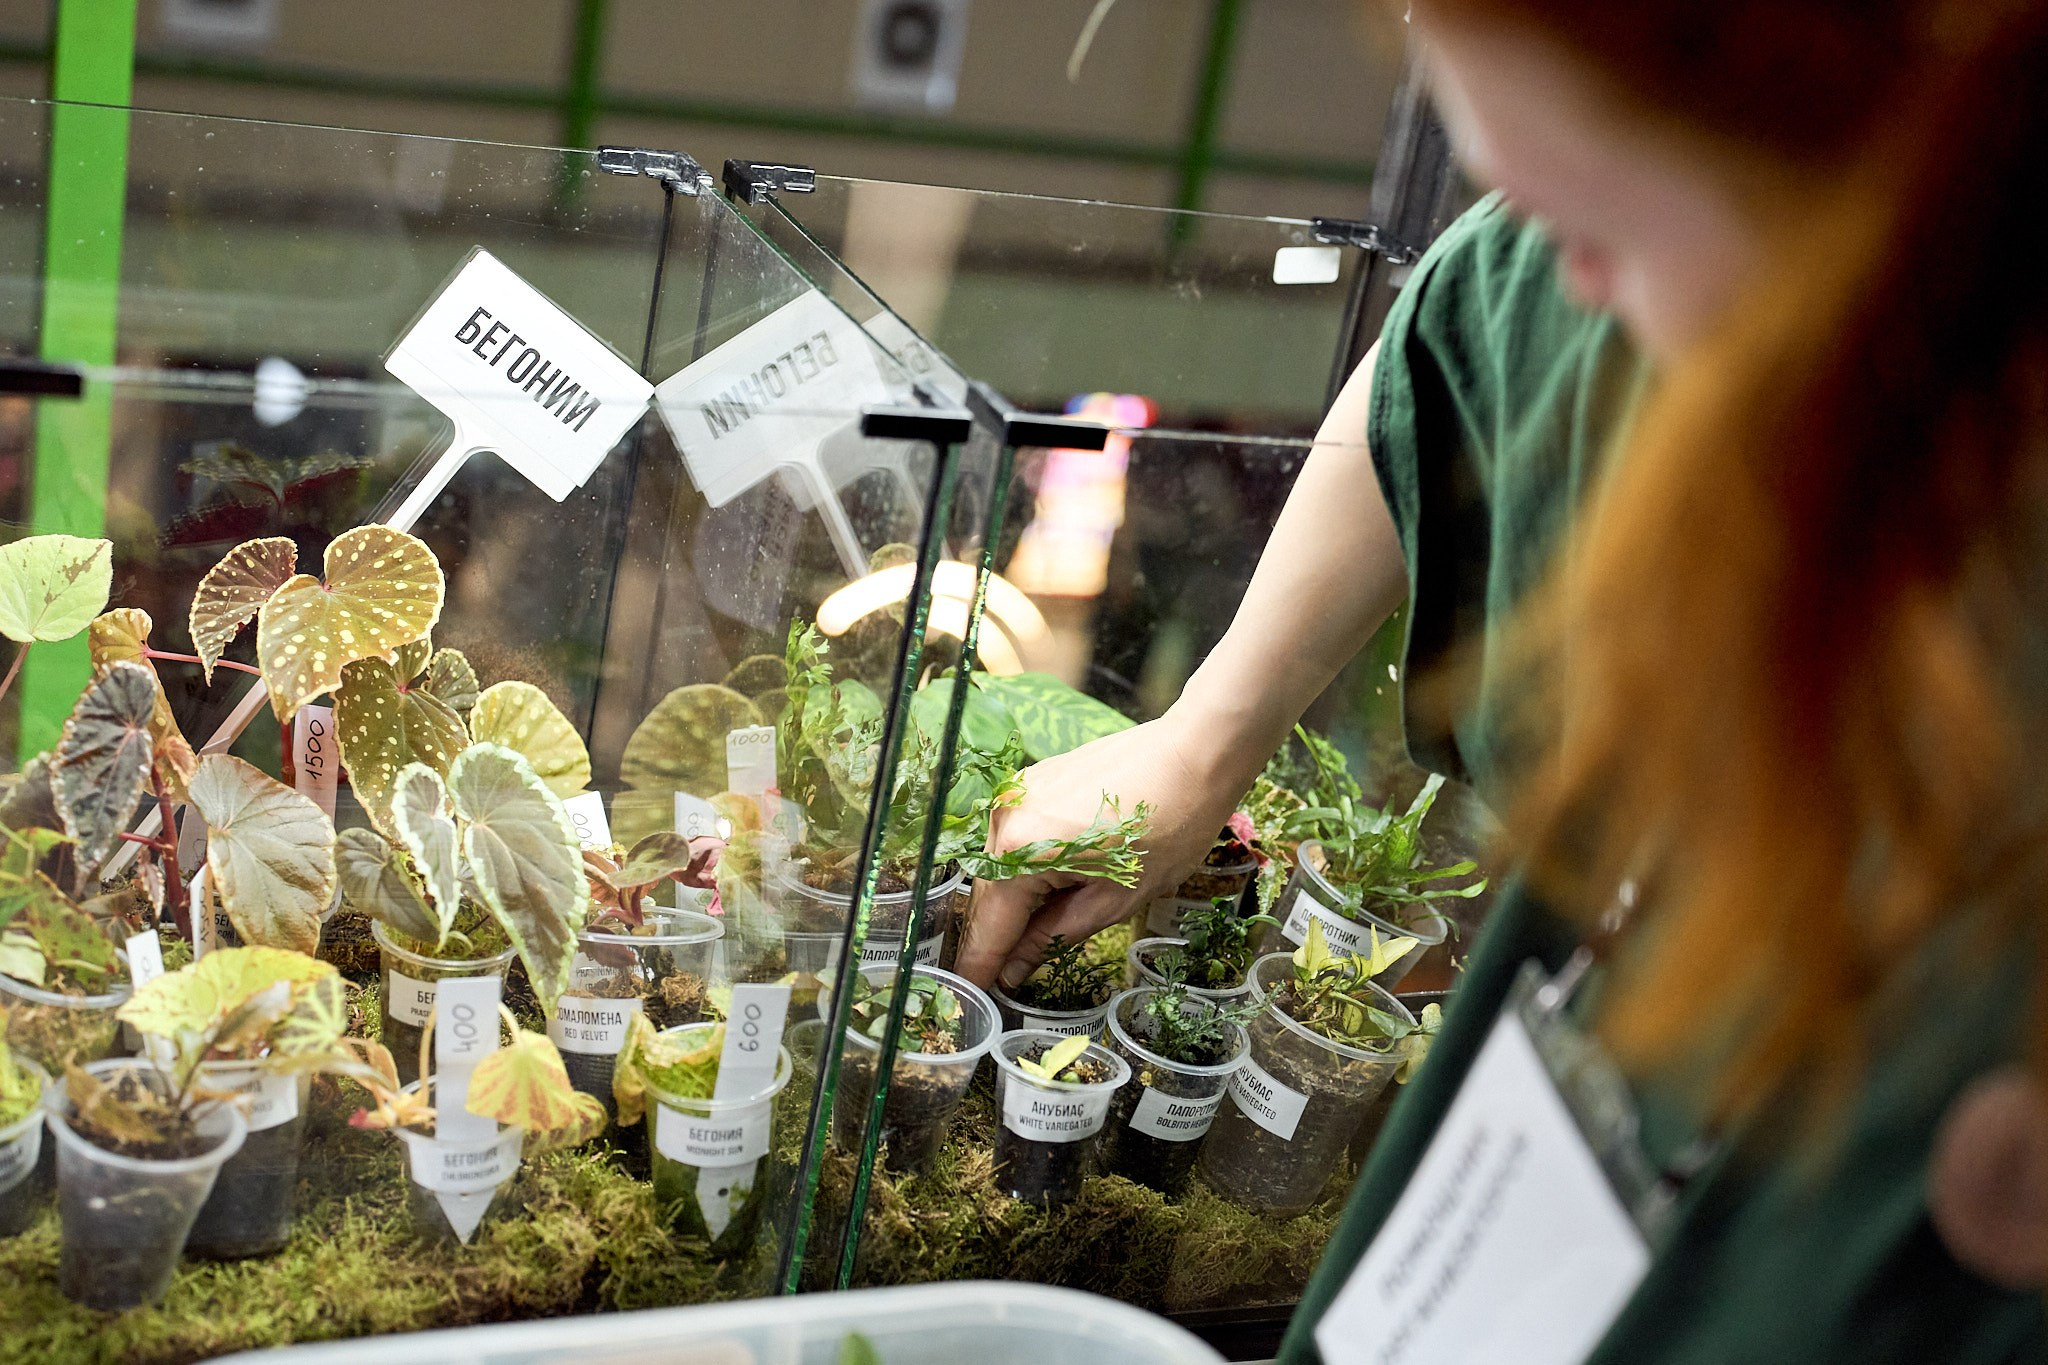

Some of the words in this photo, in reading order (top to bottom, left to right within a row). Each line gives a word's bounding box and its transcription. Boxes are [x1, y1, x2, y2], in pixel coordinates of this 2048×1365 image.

[454, 306, 602, 433] БЕГОНИИ
[305, 719, 325, 780] 1500
[452, 1003, 477, 1053] 400
[564, 1027, 578, 1040] RED
[581, 1029, 608, 1042] VELVET
[738, 1003, 762, 1052] 600
[1031, 1101, 1084, 1118] АНУБИАС
[1239, 1084, 1276, 1121] VARIEGATED
[689, 1127, 743, 1142] БЕГОНИЯ
[1019, 1115, 1043, 1130] WHITE
[1045, 1116, 1093, 1132] VARIEGATED
[1156, 1116, 1191, 1130] BOLBITIS
